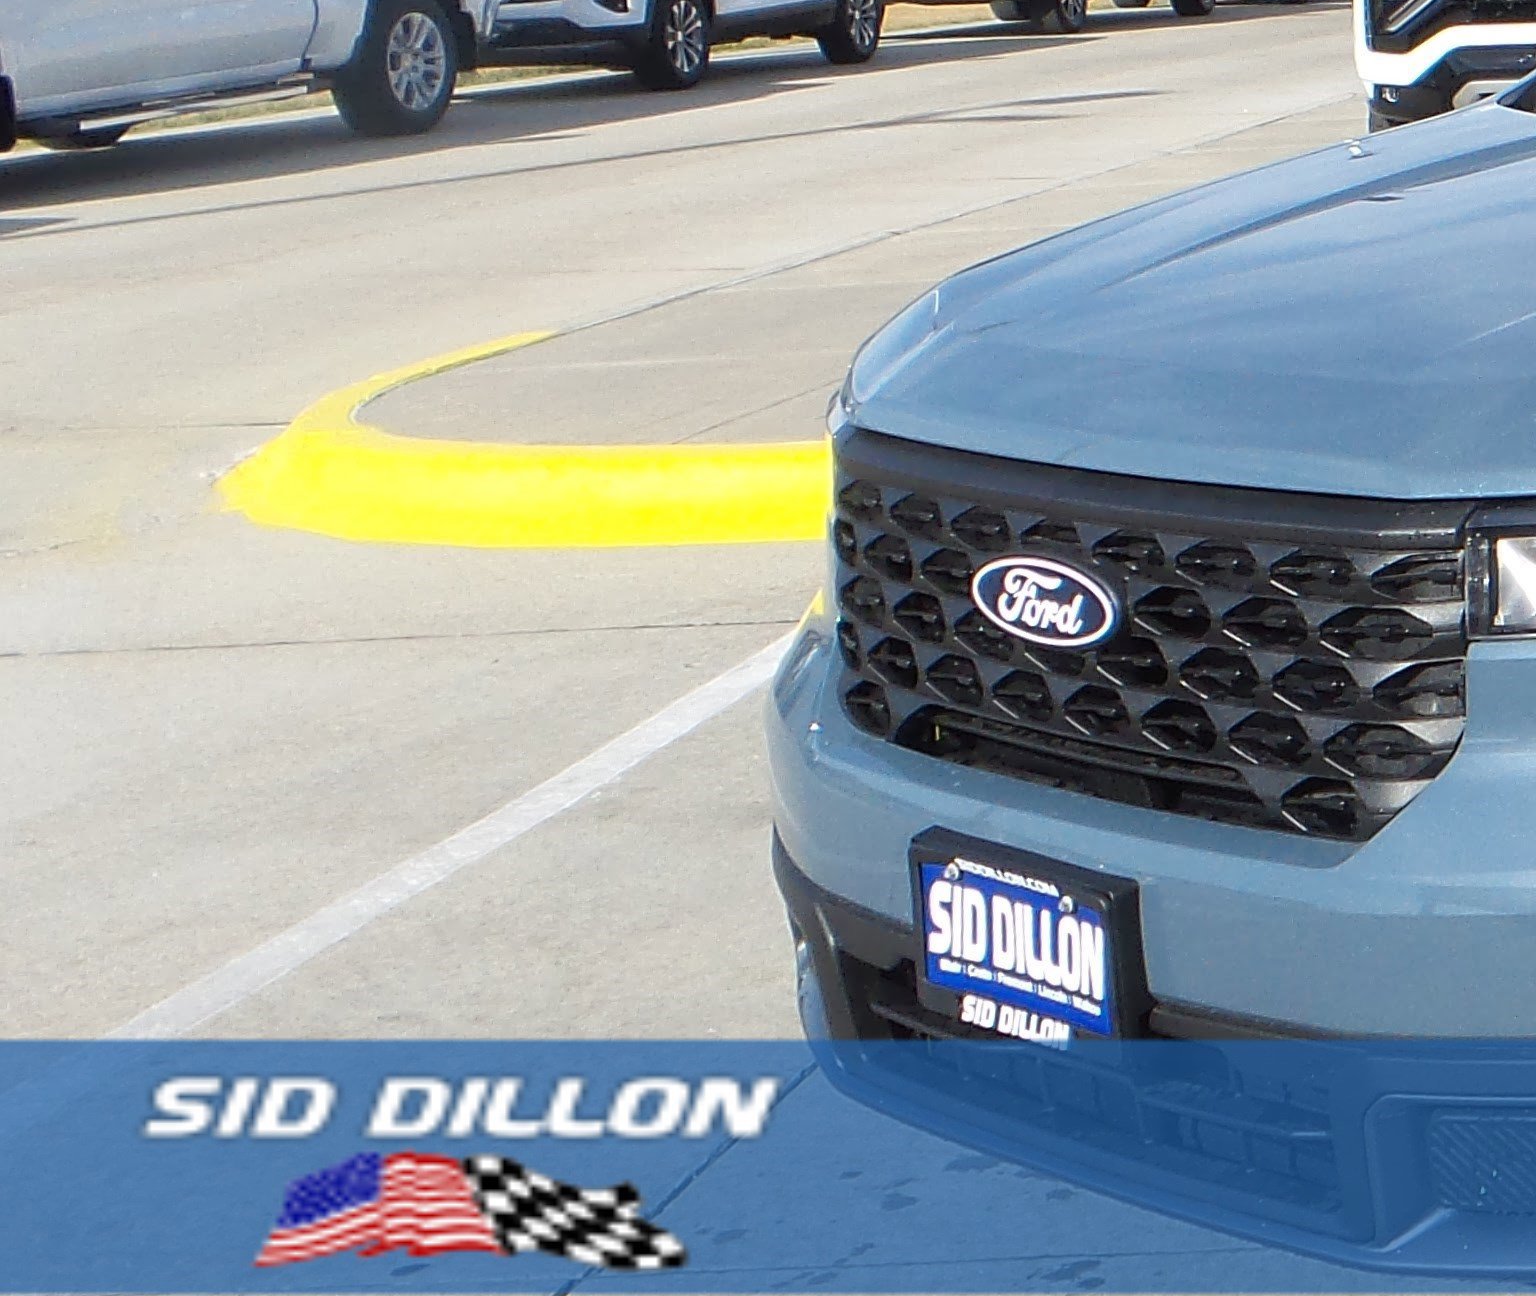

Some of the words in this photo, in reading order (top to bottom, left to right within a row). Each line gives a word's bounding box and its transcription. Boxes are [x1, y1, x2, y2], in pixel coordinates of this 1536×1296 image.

[998, 567, 1084, 635] Ford
[928, 880, 987, 963] SID
[992, 894, 1104, 1001] DILLON
[961, 994, 997, 1029] SID
[997, 1005, 1070, 1051] DILLON
